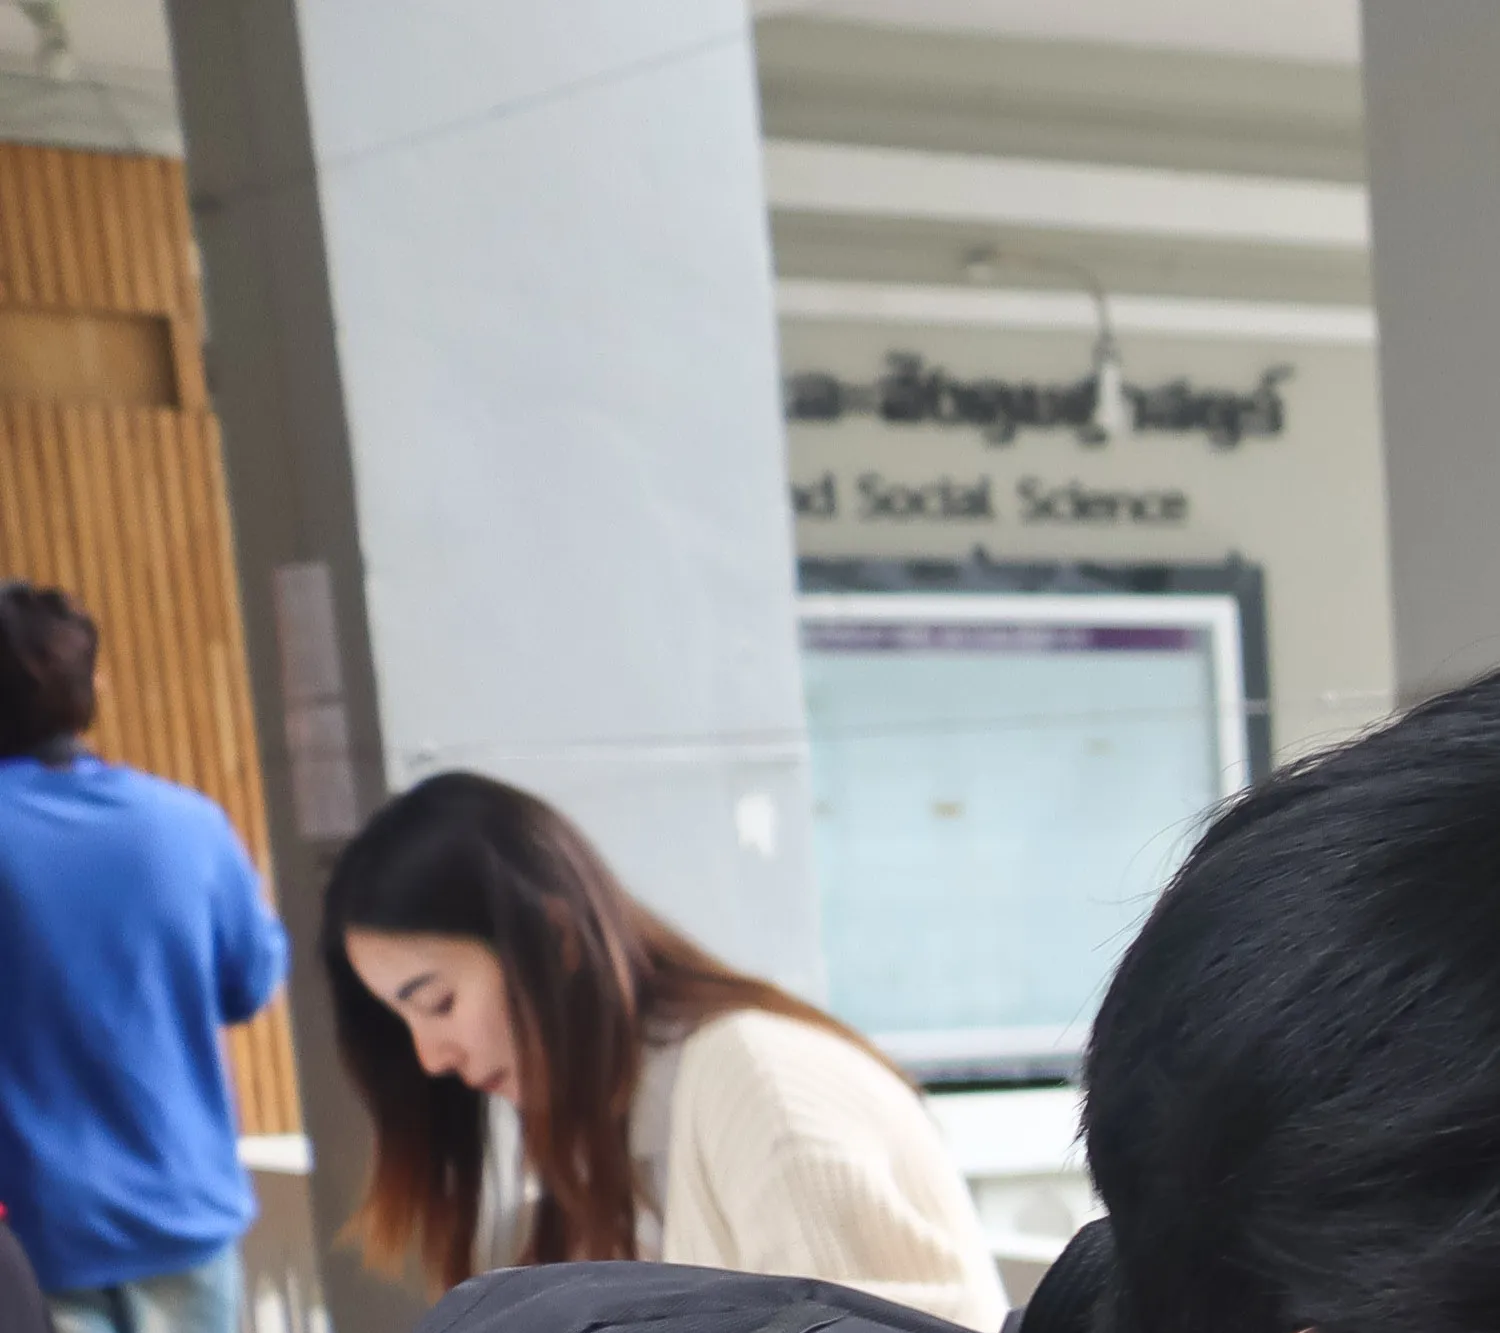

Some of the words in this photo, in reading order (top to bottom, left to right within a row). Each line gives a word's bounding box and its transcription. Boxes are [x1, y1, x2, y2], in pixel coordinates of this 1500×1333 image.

[792, 470, 836, 521] nd
[857, 472, 993, 522] Social
[1017, 476, 1188, 525] Science
